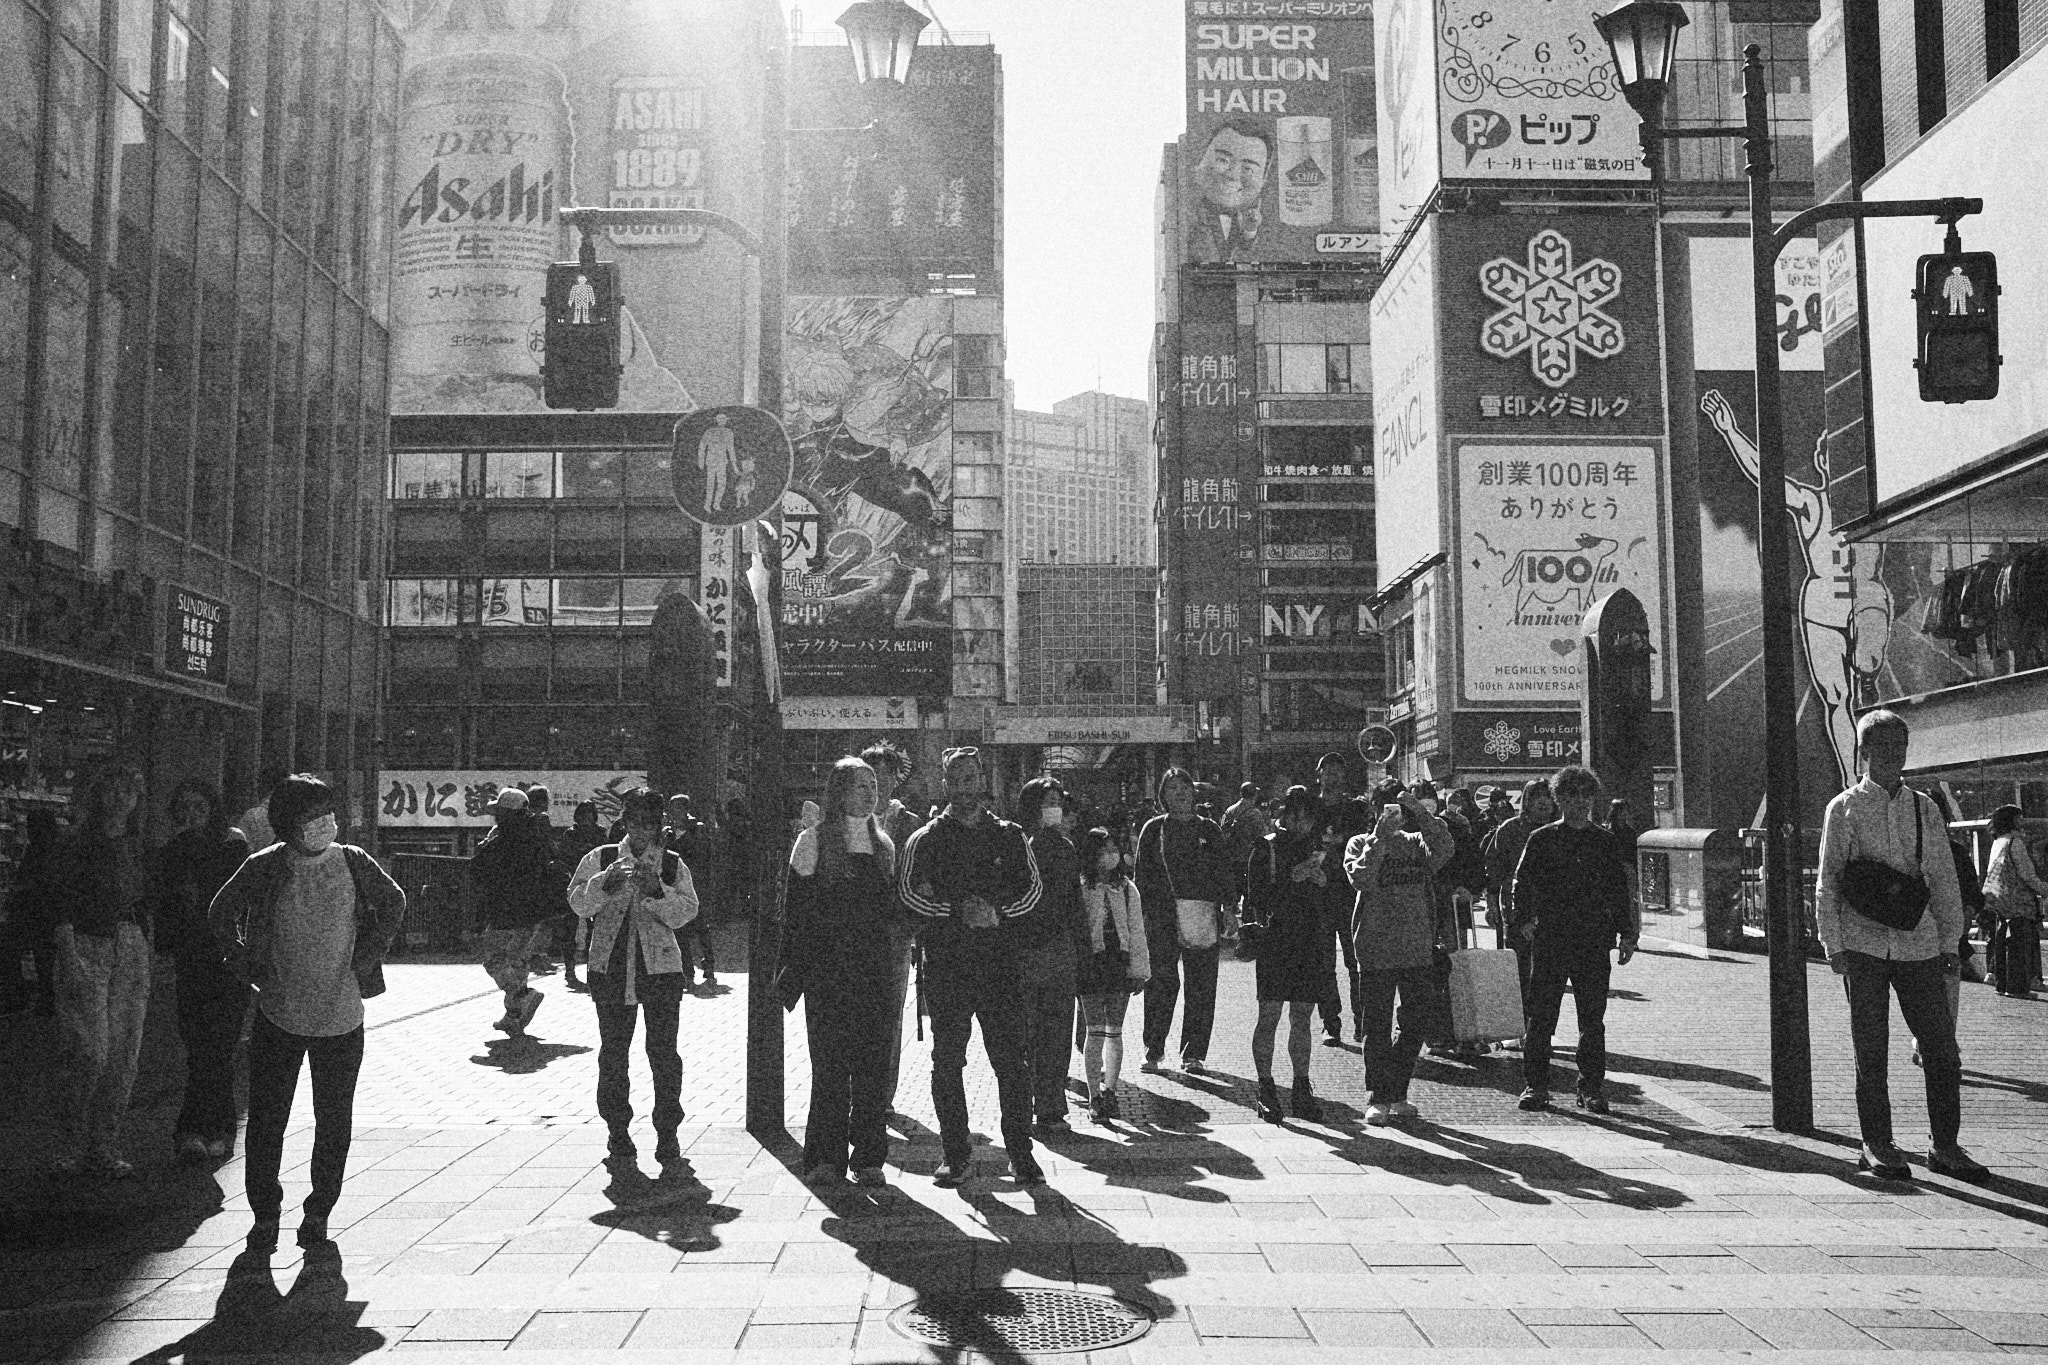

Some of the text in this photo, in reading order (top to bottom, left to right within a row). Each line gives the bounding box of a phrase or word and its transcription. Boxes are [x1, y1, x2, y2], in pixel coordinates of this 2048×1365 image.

[1471, 11, 1493, 28] 8
[1197, 24, 1316, 50] SUPER
[1501, 33, 1521, 52] 7
[1567, 32, 1587, 55] 5
[1534, 41, 1551, 63] 6
[1197, 56, 1329, 81] MILLION
[614, 91, 702, 130] ASAHI
[1197, 88, 1287, 113] HAIR
[1520, 113, 1600, 145] ピップ
[613, 148, 700, 188] 1889
[398, 162, 554, 231] Asahi
[456, 234, 494, 259] 生
[428, 284, 520, 299] スーパードライ
[1181, 355, 1237, 380] 龍角散
[1480, 392, 1629, 417] 雪印メグミルク
[1382, 391, 1427, 479] FANCL
[1478, 461, 1638, 487] 創業100周年
[1183, 477, 1238, 502] 龍角散
[1501, 497, 1618, 520] ありがとう
[1527, 555, 1619, 584] 100th
[178, 593, 220, 623] SUNDRUG
[1264, 605, 1326, 637] NY
[1495, 666, 1546, 675] MEGMILK
[1474, 682, 1503, 691] 100th
[1534, 725, 1556, 734] Love
[1527, 740, 1580, 758] 雪印メ
